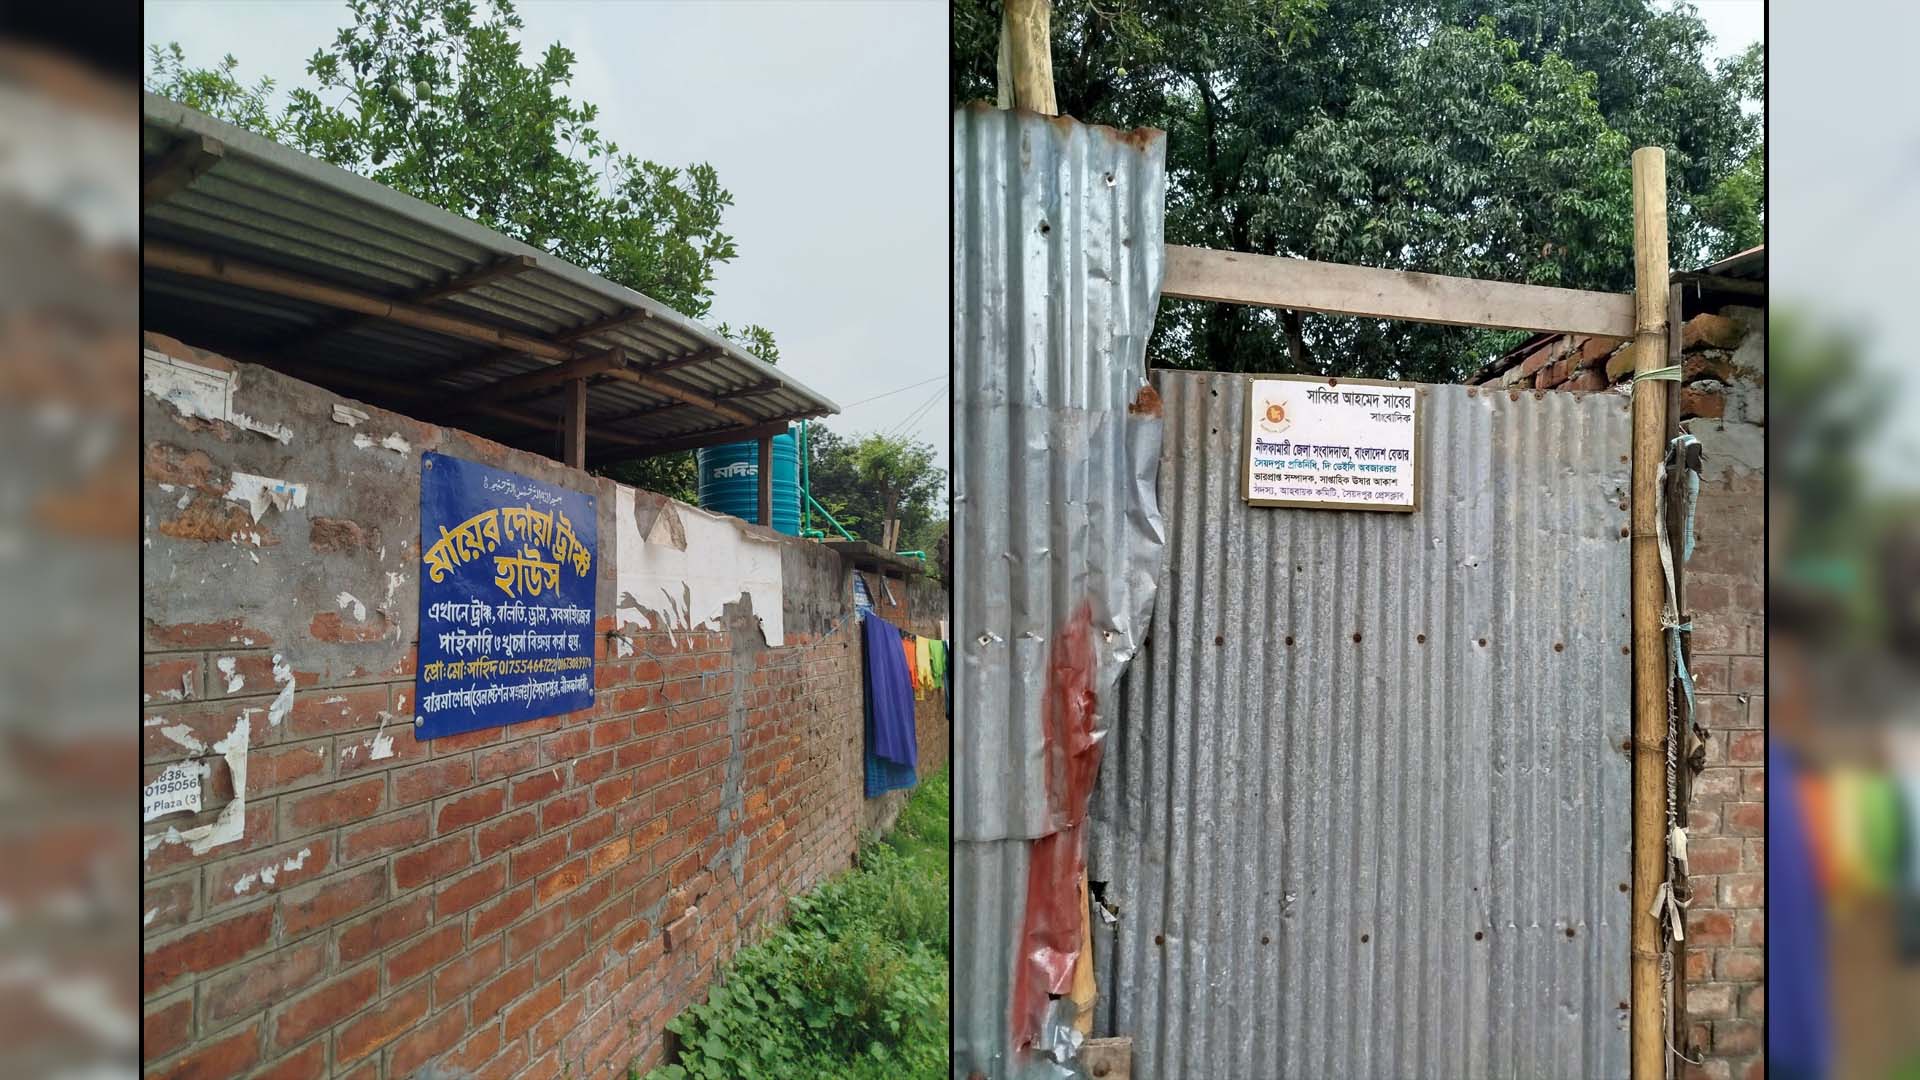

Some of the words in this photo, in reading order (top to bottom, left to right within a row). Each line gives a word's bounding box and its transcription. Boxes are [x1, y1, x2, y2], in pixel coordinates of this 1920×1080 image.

[1306, 386, 1339, 405] সাব্বির
[1342, 391, 1380, 409] আহমেদ
[1383, 393, 1412, 409] সাবের
[1370, 411, 1411, 423] সাংবাদিক
[1255, 437, 1291, 456] নীলফামারী
[1293, 444, 1311, 458] জেলা
[1313, 445, 1352, 461] সংবাদদাতা,
[1354, 447, 1386, 461] বাংলাদেশ
[1389, 448, 1409, 461] বেতার
[713, 462, 758, 478] মদিন
[1254, 457, 1285, 470] সৈয়দপুর
[1288, 459, 1320, 471] প্রতিনিধি,
[1358, 464, 1397, 473] অবজারভার
[1254, 472, 1282, 482] ভারপ্রাপ্ত
[1319, 474, 1350, 485] সাপ্তাহিক
[1373, 478, 1398, 486] আকাশ
[423, 509, 501, 583] মায়ের
[502, 503, 553, 549] দোয়া
[494, 544, 560, 598] হাউস
[428, 601, 469, 623] এখানে
[439, 627, 493, 656] পাইকারি
[494, 637, 501, 651] ও
[501, 630, 527, 658] খুচরা
[527, 630, 551, 652] বিক্রয়
[552, 630, 567, 651] করা
[154, 799, 182, 811] Plaza
